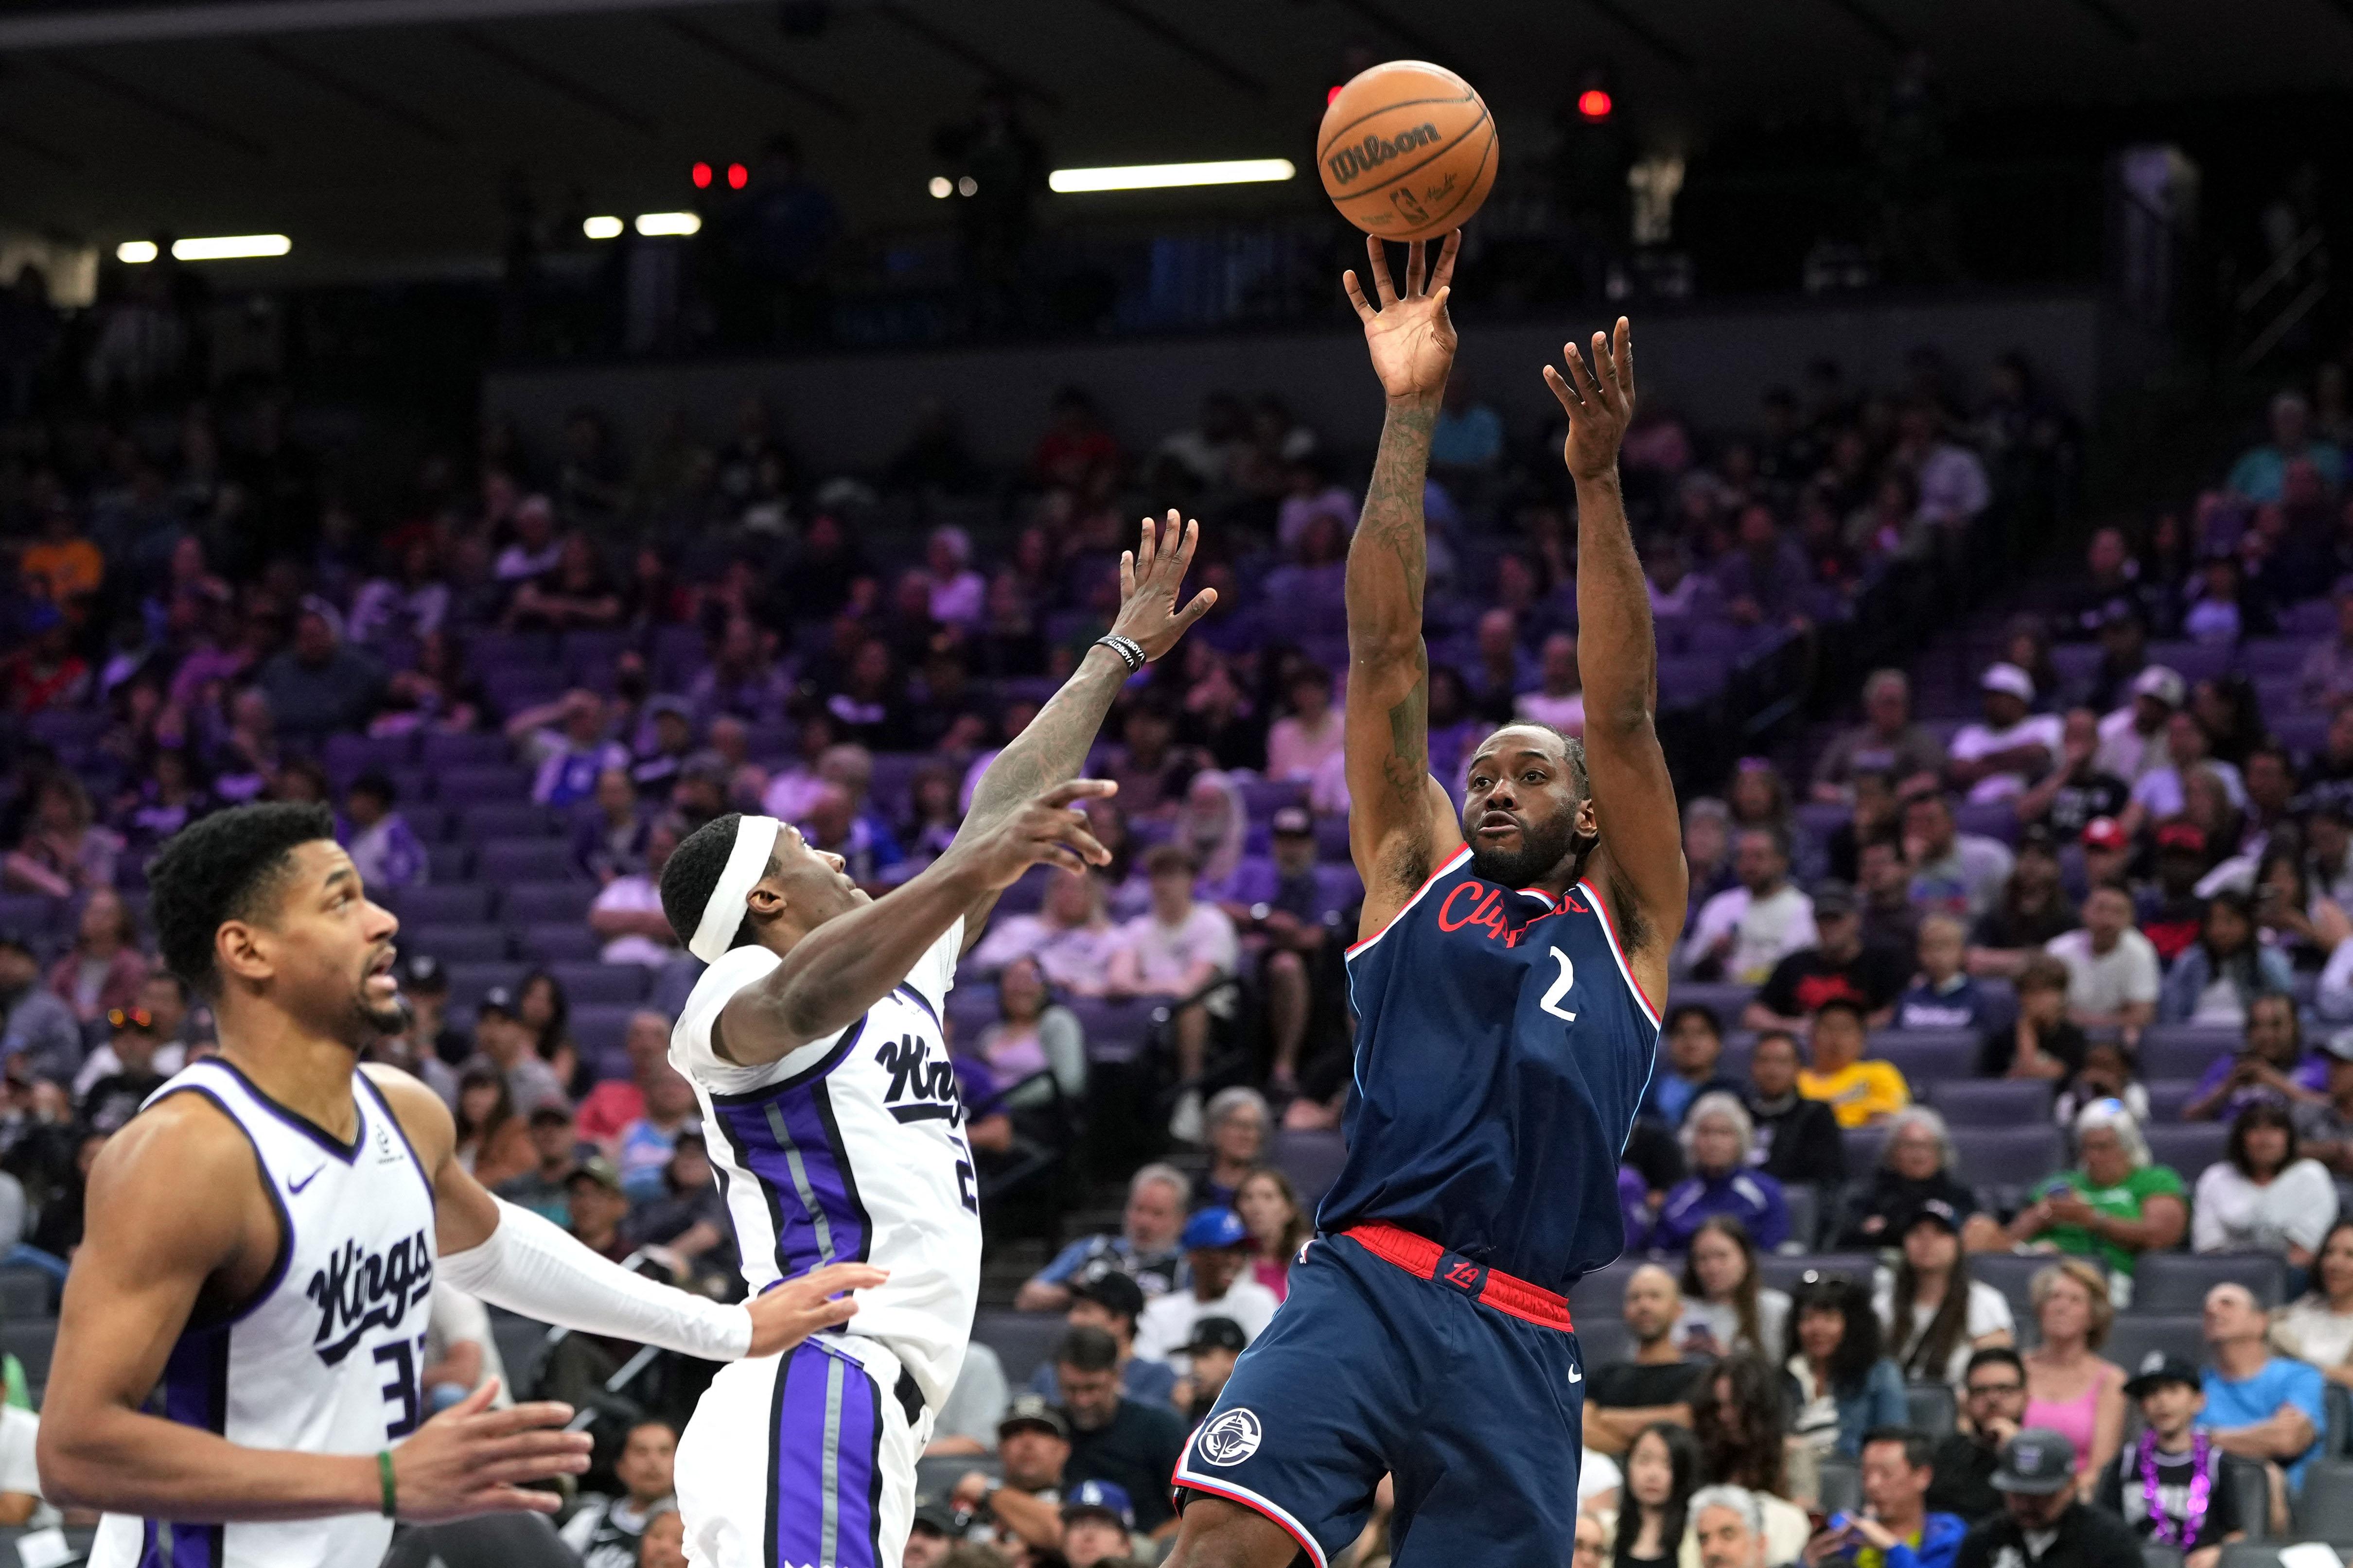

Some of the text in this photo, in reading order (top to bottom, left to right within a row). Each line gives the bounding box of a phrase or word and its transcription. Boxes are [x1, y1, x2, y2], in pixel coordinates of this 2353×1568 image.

[1328, 123, 1441, 185] Wilson
[1540, 946, 1576, 1022] 2
[307, 1227, 433, 1367] Kings
[1444, 1262, 1479, 1289] LA
